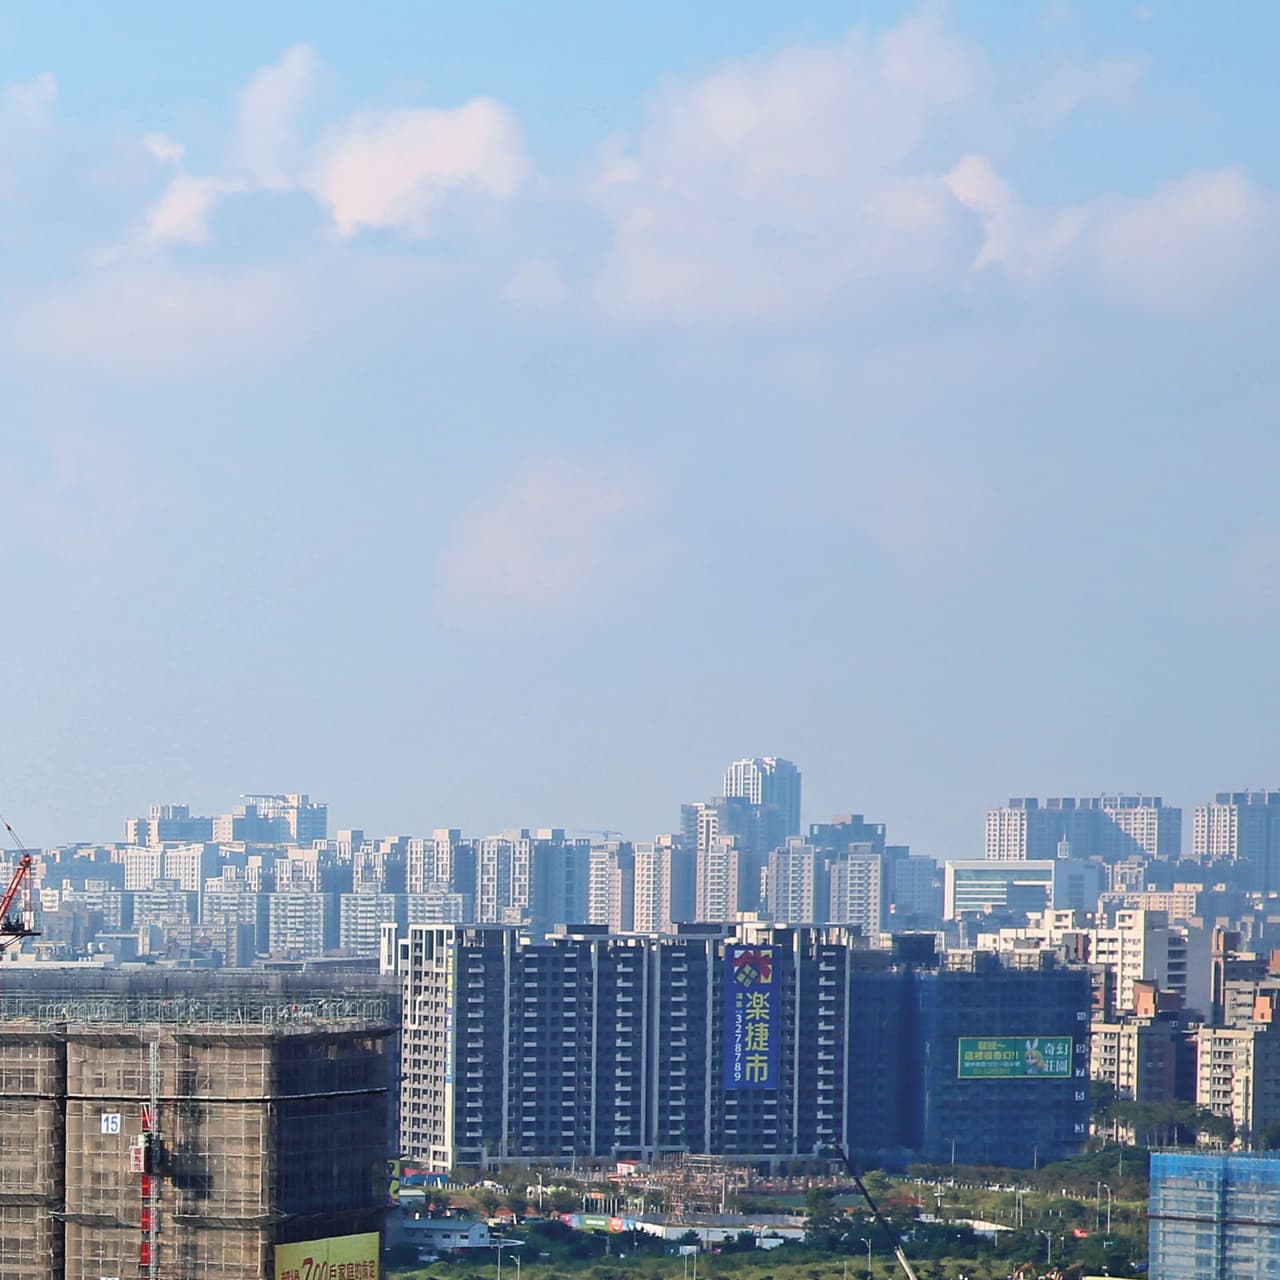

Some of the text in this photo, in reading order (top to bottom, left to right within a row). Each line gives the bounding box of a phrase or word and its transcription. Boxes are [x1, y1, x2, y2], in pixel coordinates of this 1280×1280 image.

[734, 1015, 742, 1081] 3278789
[745, 991, 770, 1083] 楽捷市
[103, 1115, 118, 1132] 15
